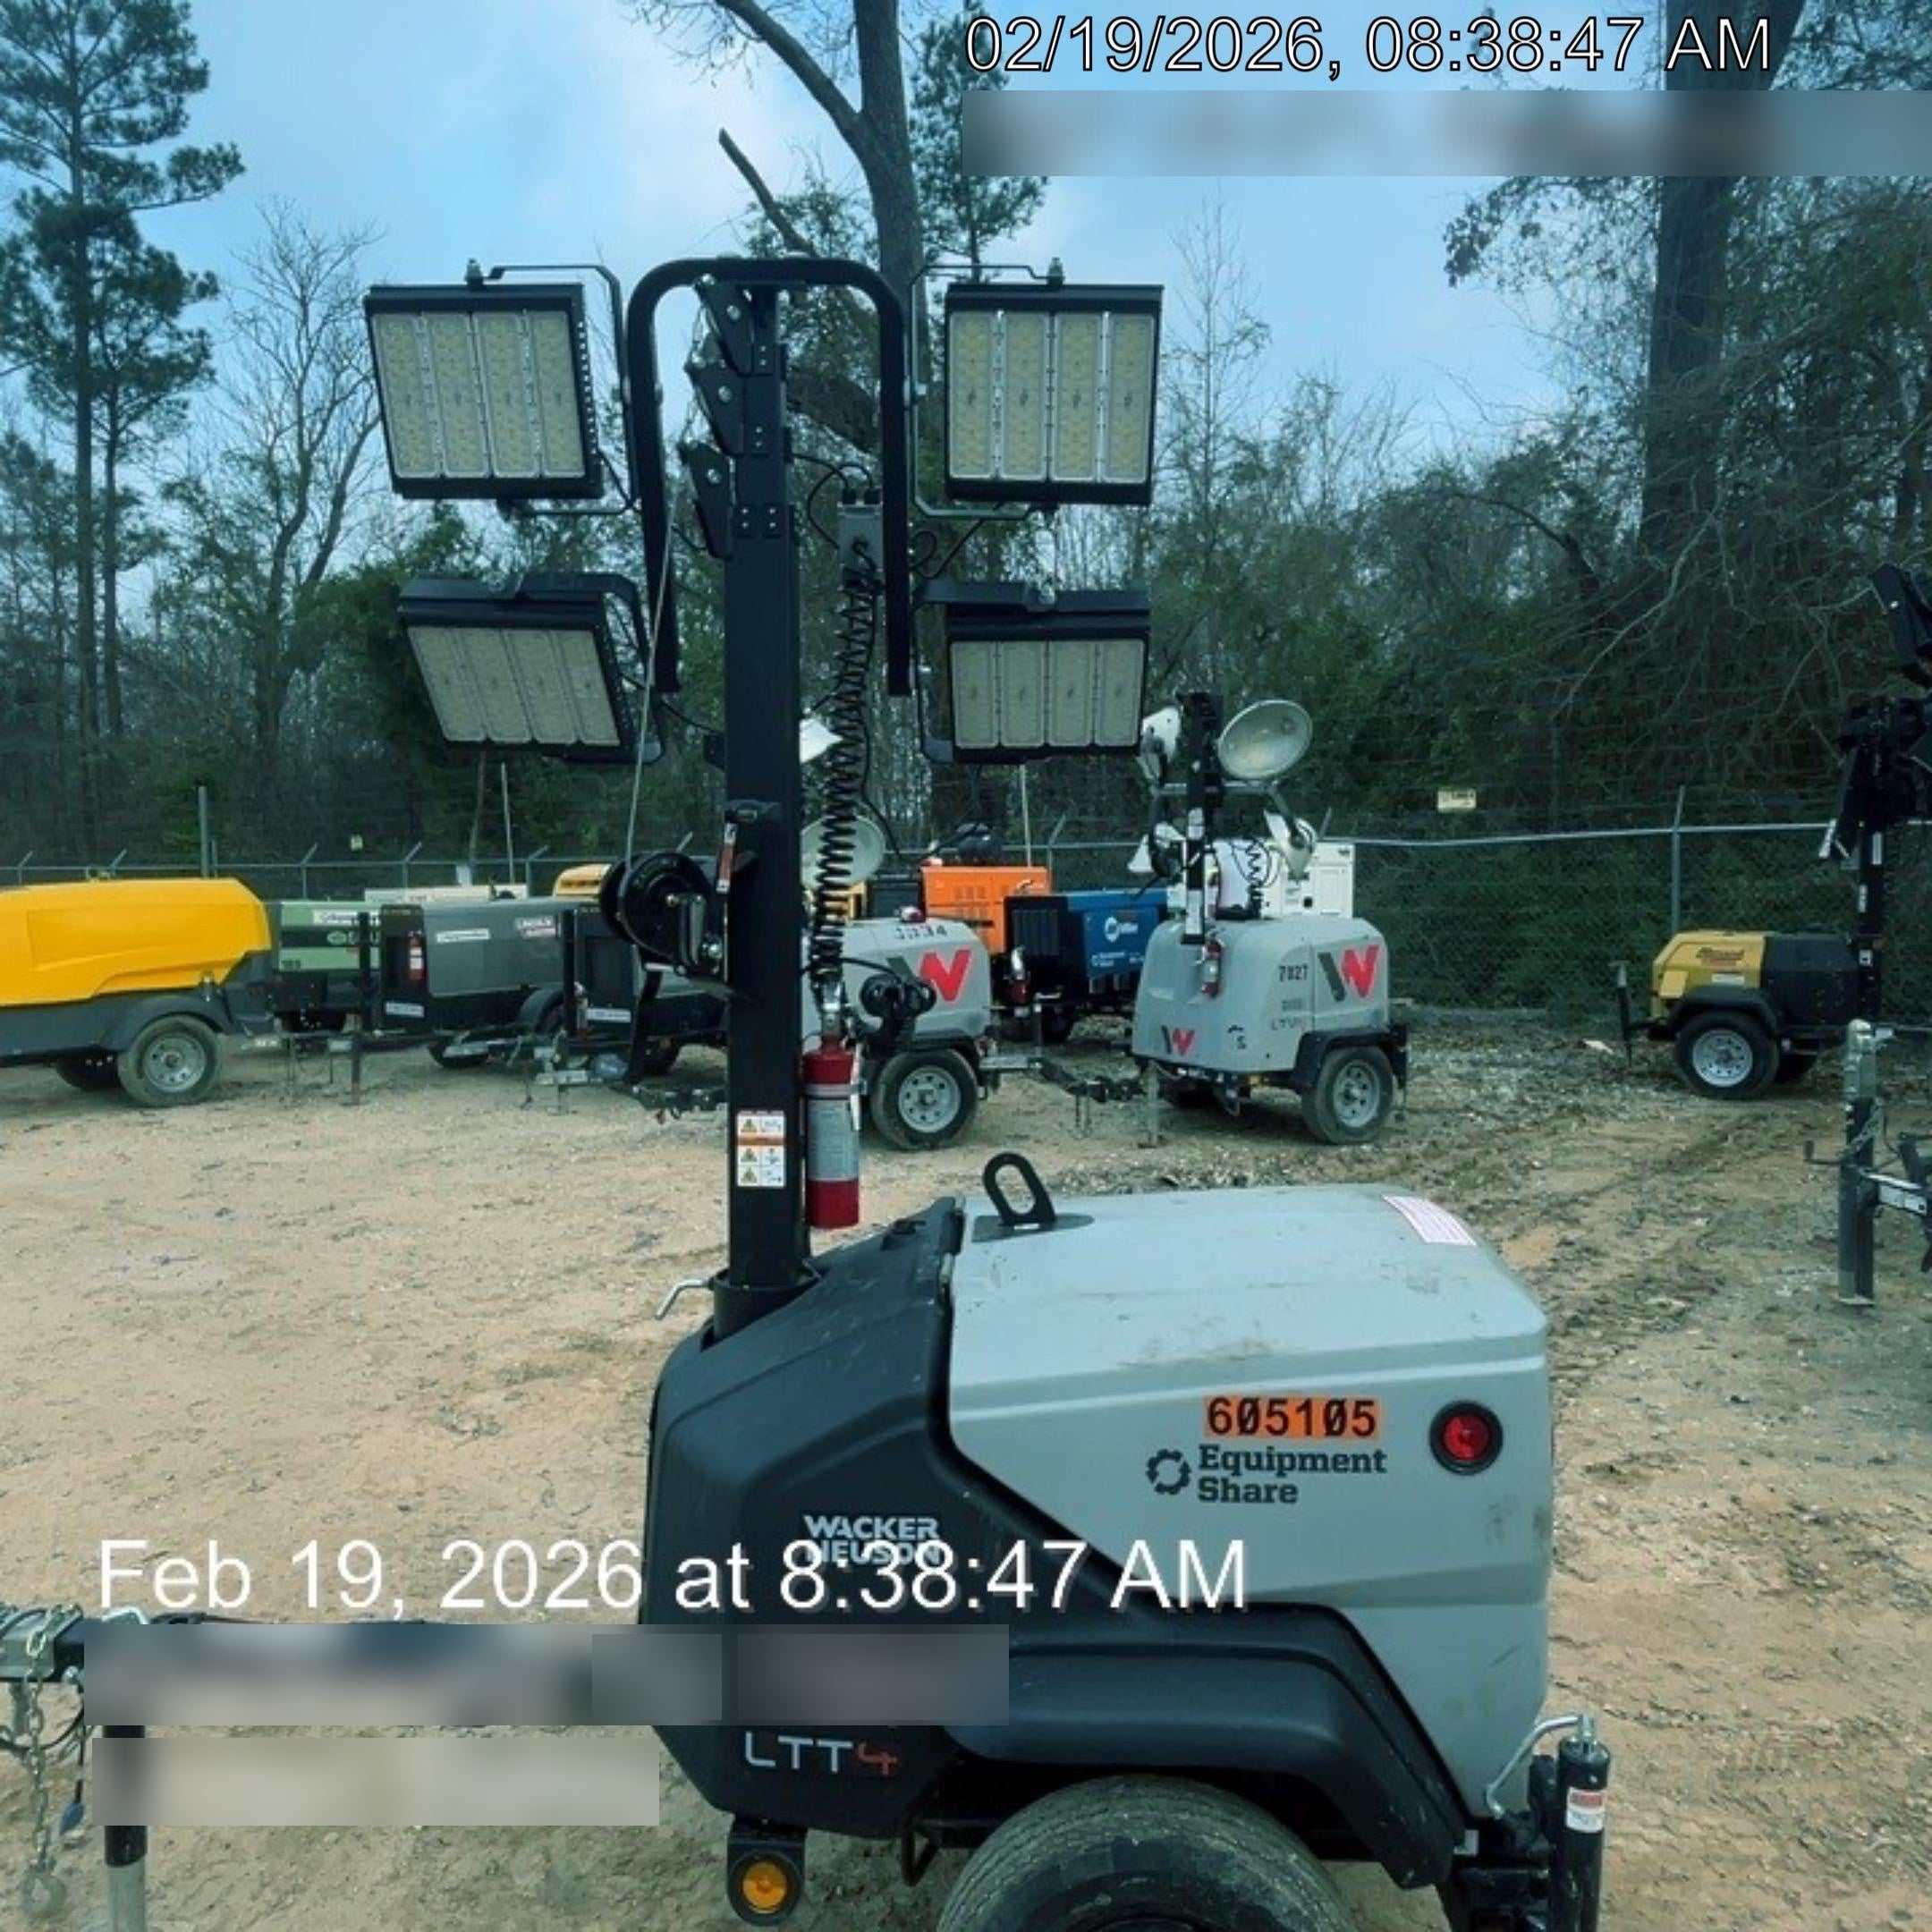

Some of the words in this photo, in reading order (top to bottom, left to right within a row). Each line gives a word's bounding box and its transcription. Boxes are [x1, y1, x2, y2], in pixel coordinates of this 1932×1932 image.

[1208, 1396, 1377, 1437] 605105
[1198, 1443, 1387, 1478] Equipment
[1198, 1477, 1298, 1504] Share
[803, 1513, 940, 1540] WACKER
[744, 1731, 898, 1775] LTT4
